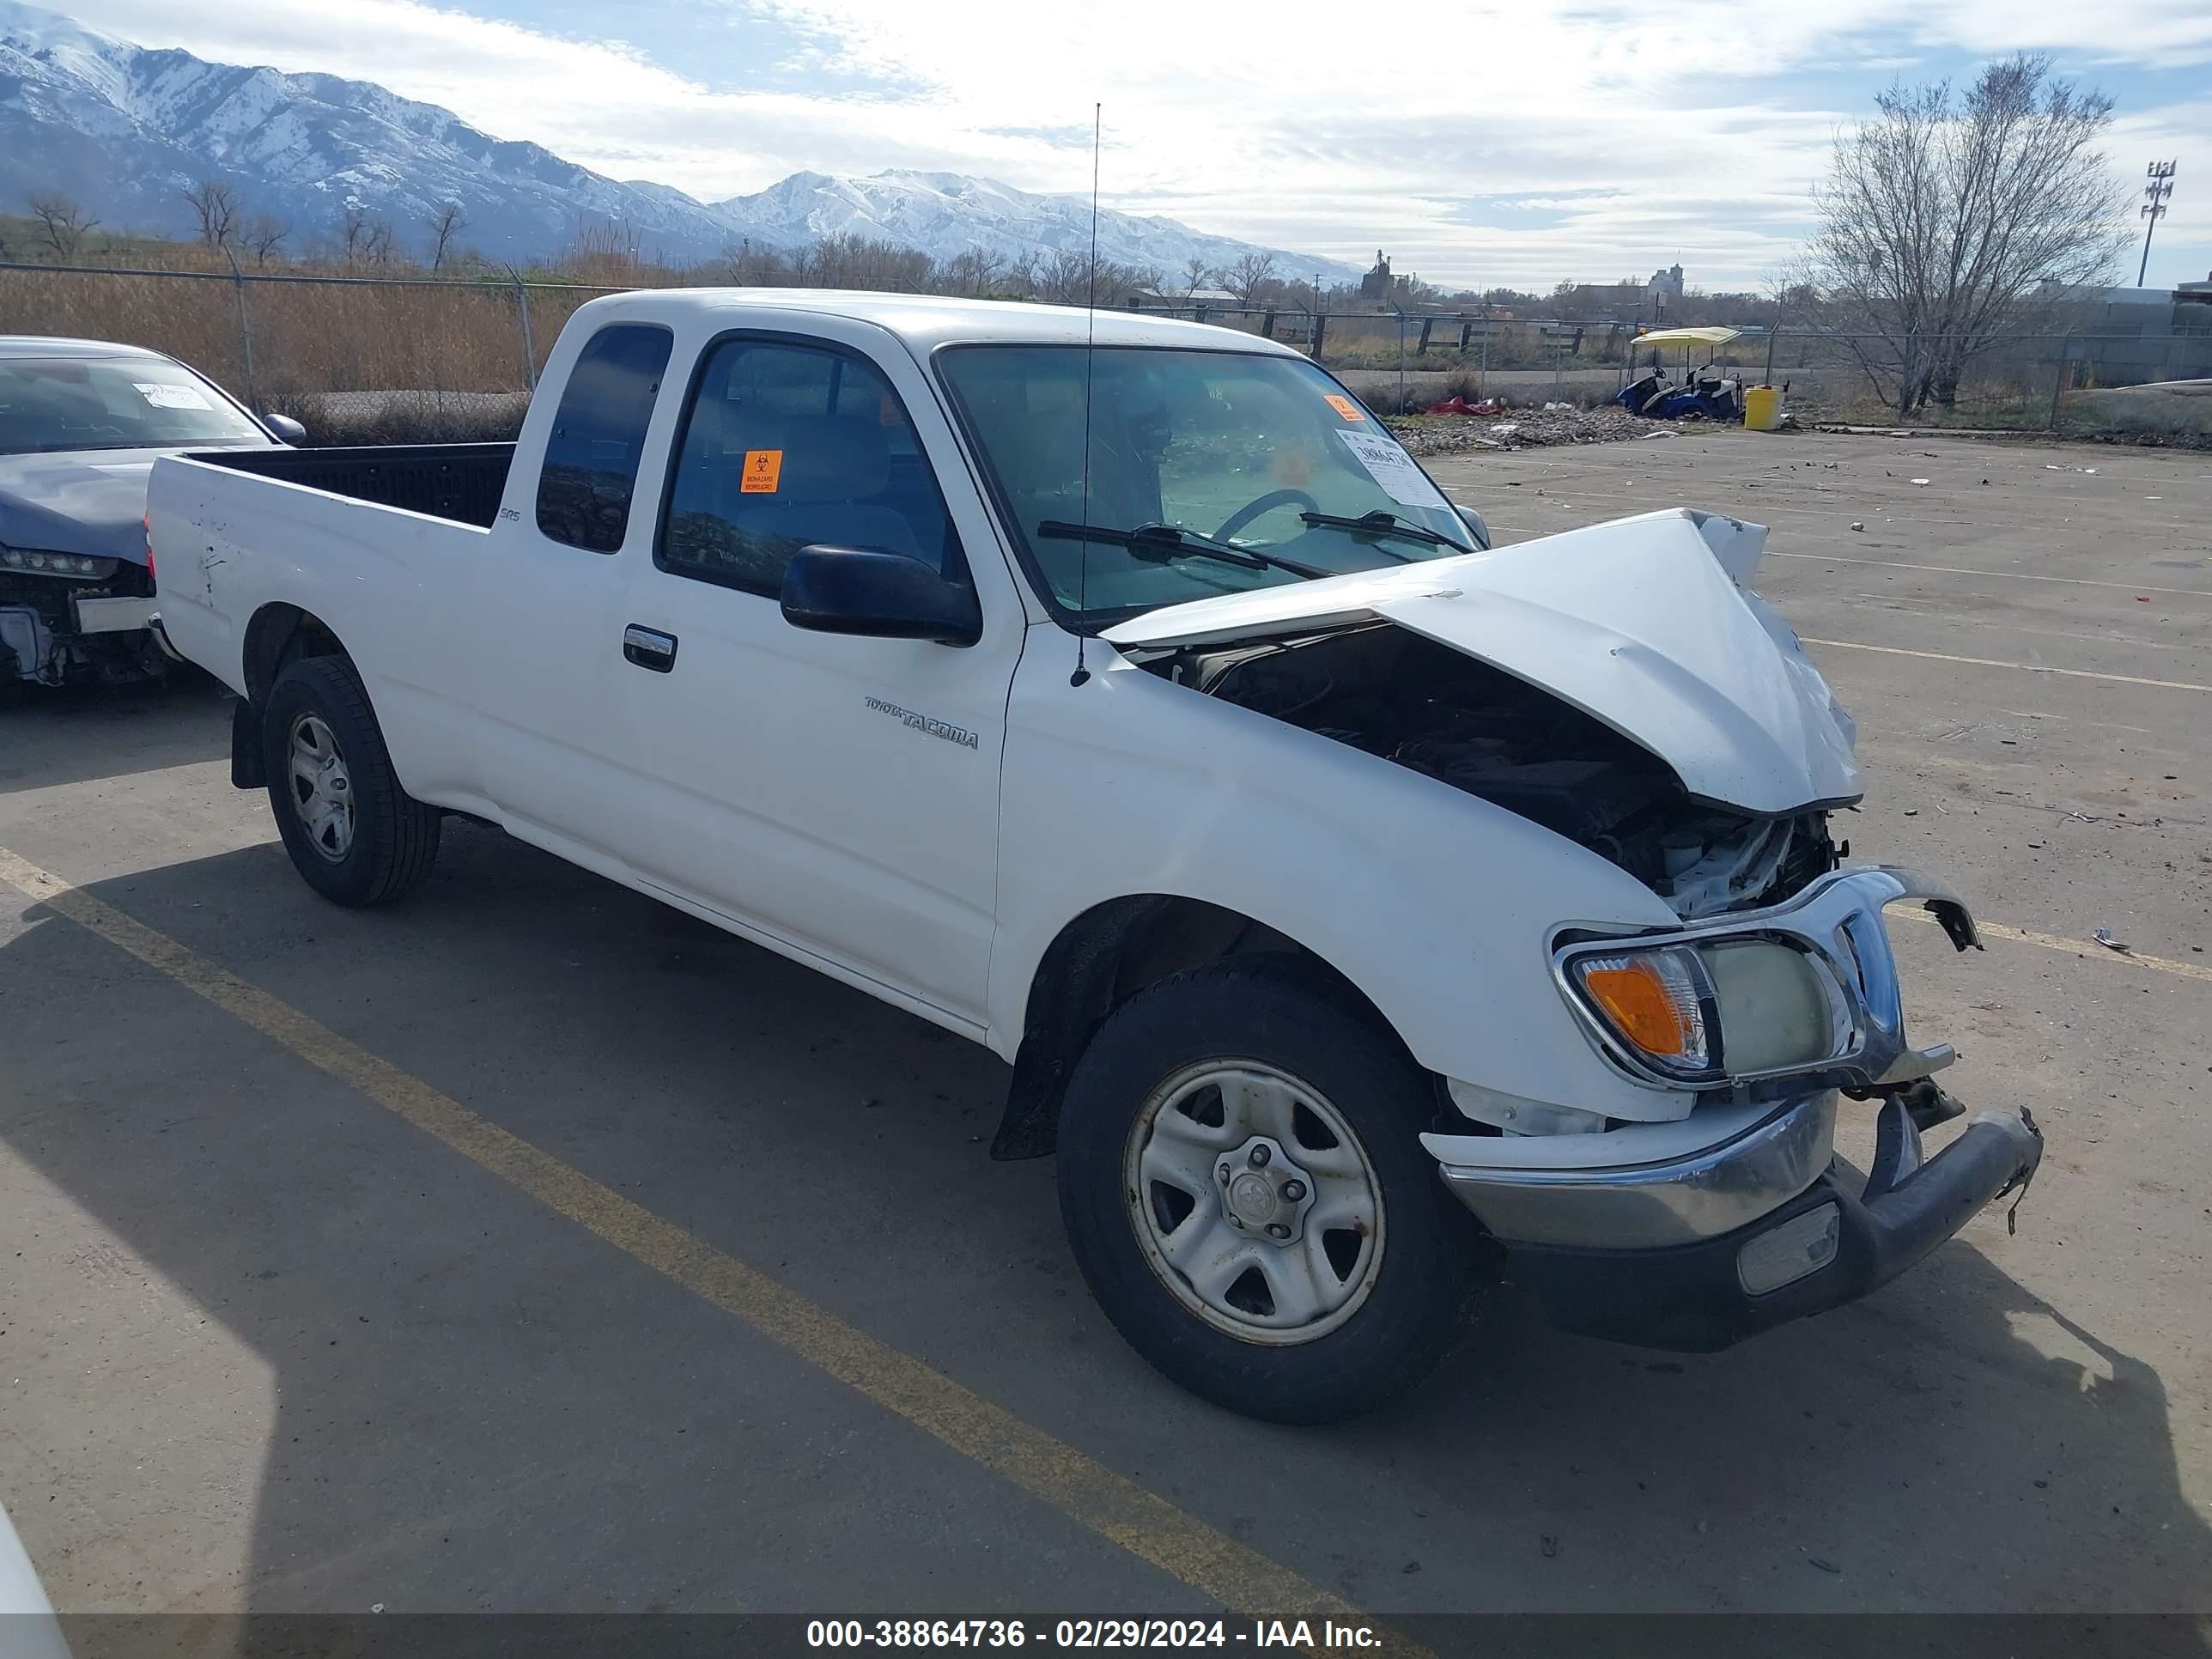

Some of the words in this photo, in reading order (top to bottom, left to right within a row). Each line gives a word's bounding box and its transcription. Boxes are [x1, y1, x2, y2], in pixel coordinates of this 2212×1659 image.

[1357, 446, 1413, 468] 38864736
[500, 507, 521, 522] SR5
[901, 709, 979, 750] TACOMA
